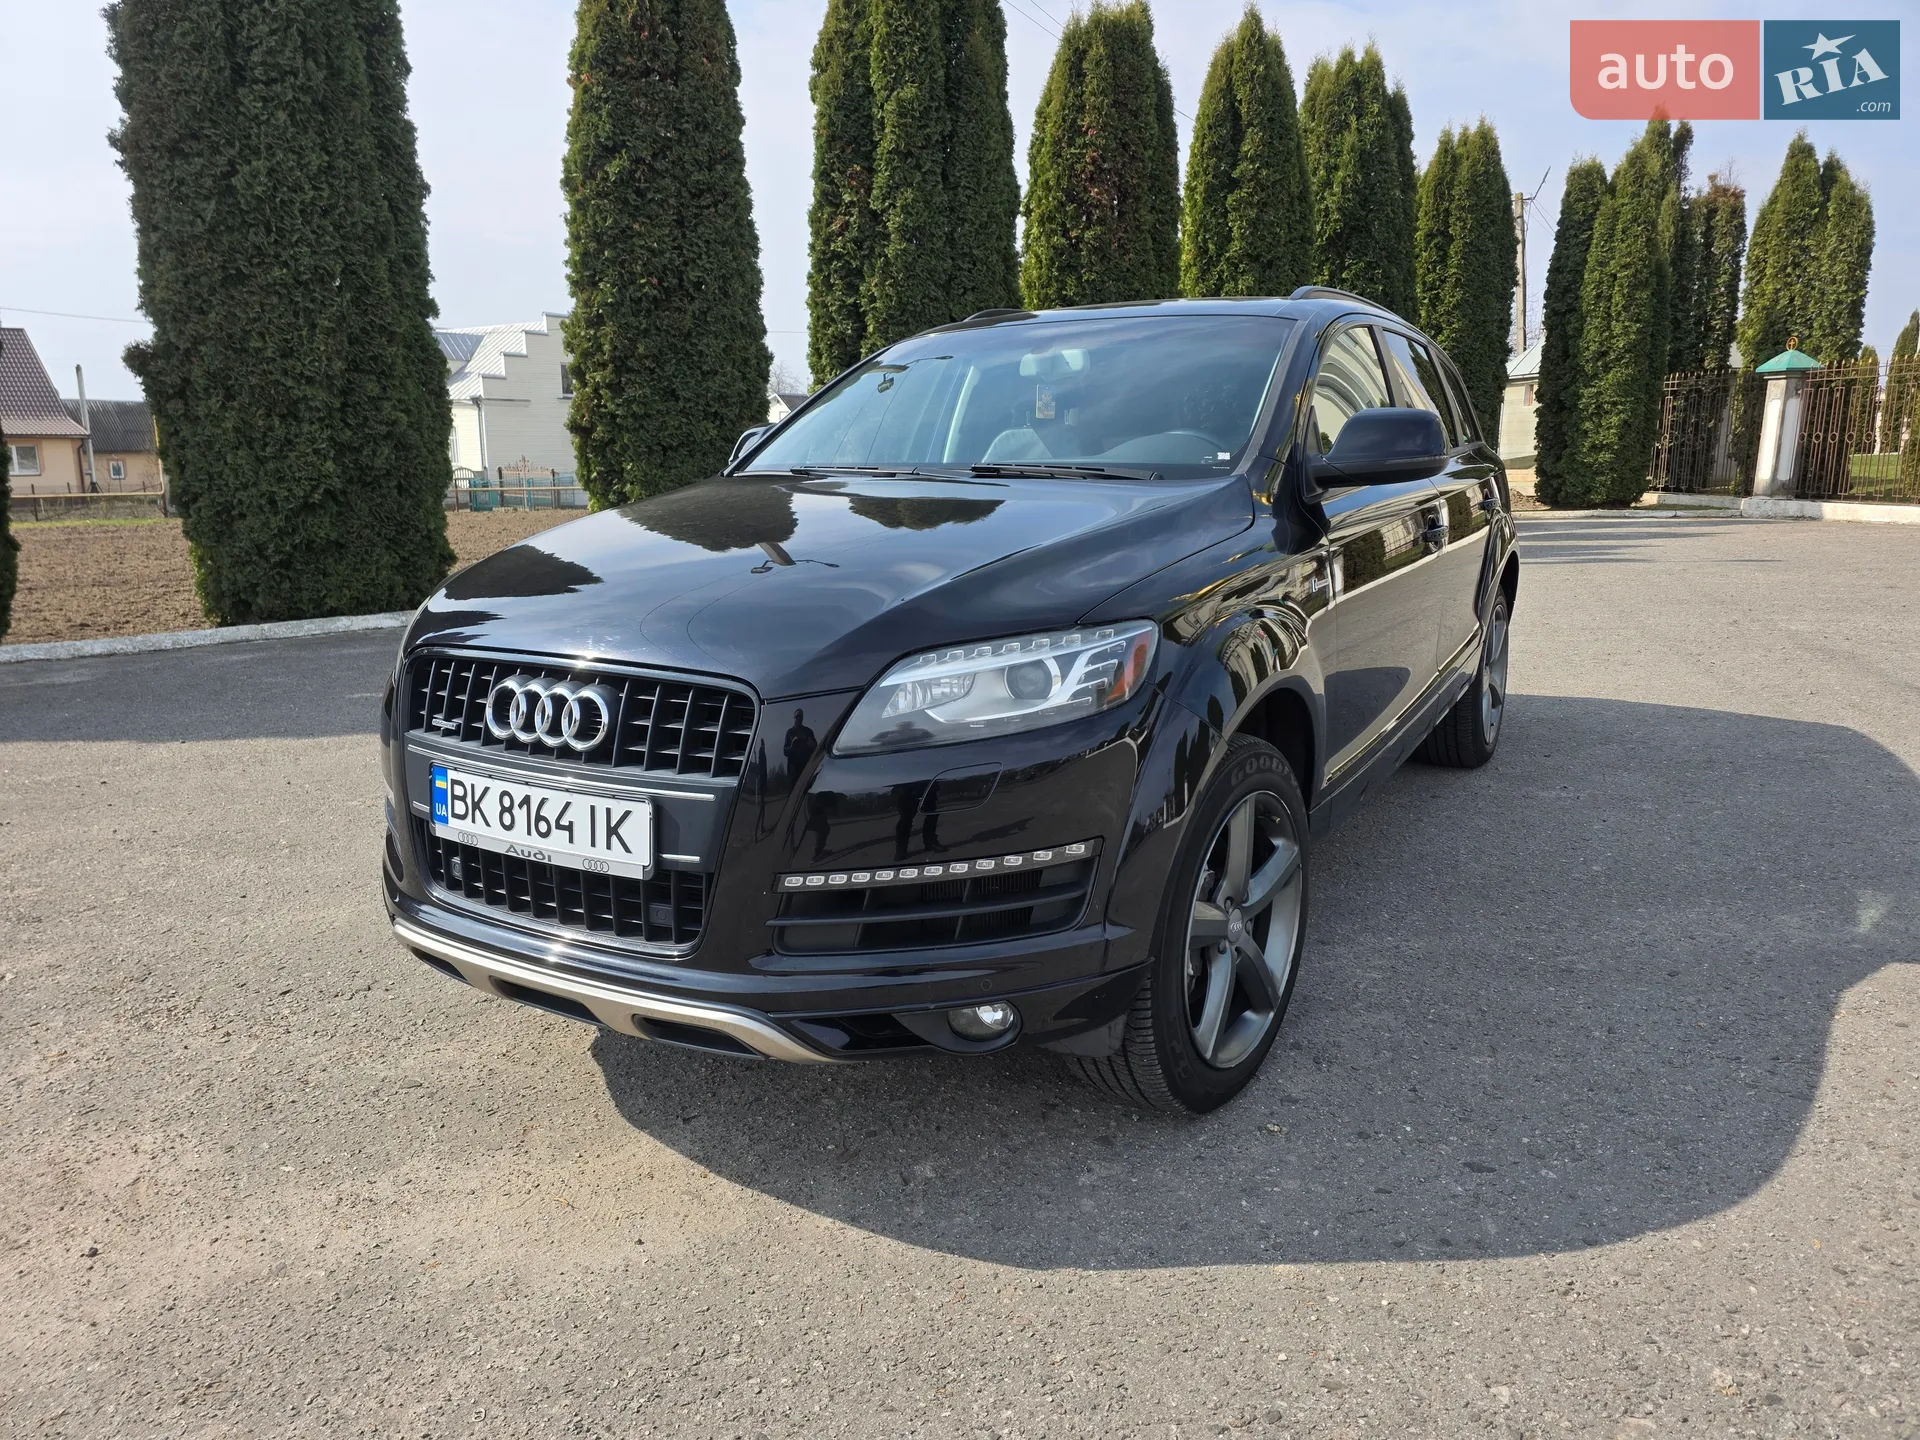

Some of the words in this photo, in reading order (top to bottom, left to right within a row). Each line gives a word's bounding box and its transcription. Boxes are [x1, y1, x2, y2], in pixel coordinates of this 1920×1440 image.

[435, 802, 447, 817] UA
[450, 778, 491, 828] BK
[498, 790, 574, 844] 8164
[589, 804, 632, 854] IK
[505, 844, 552, 862] Audi
